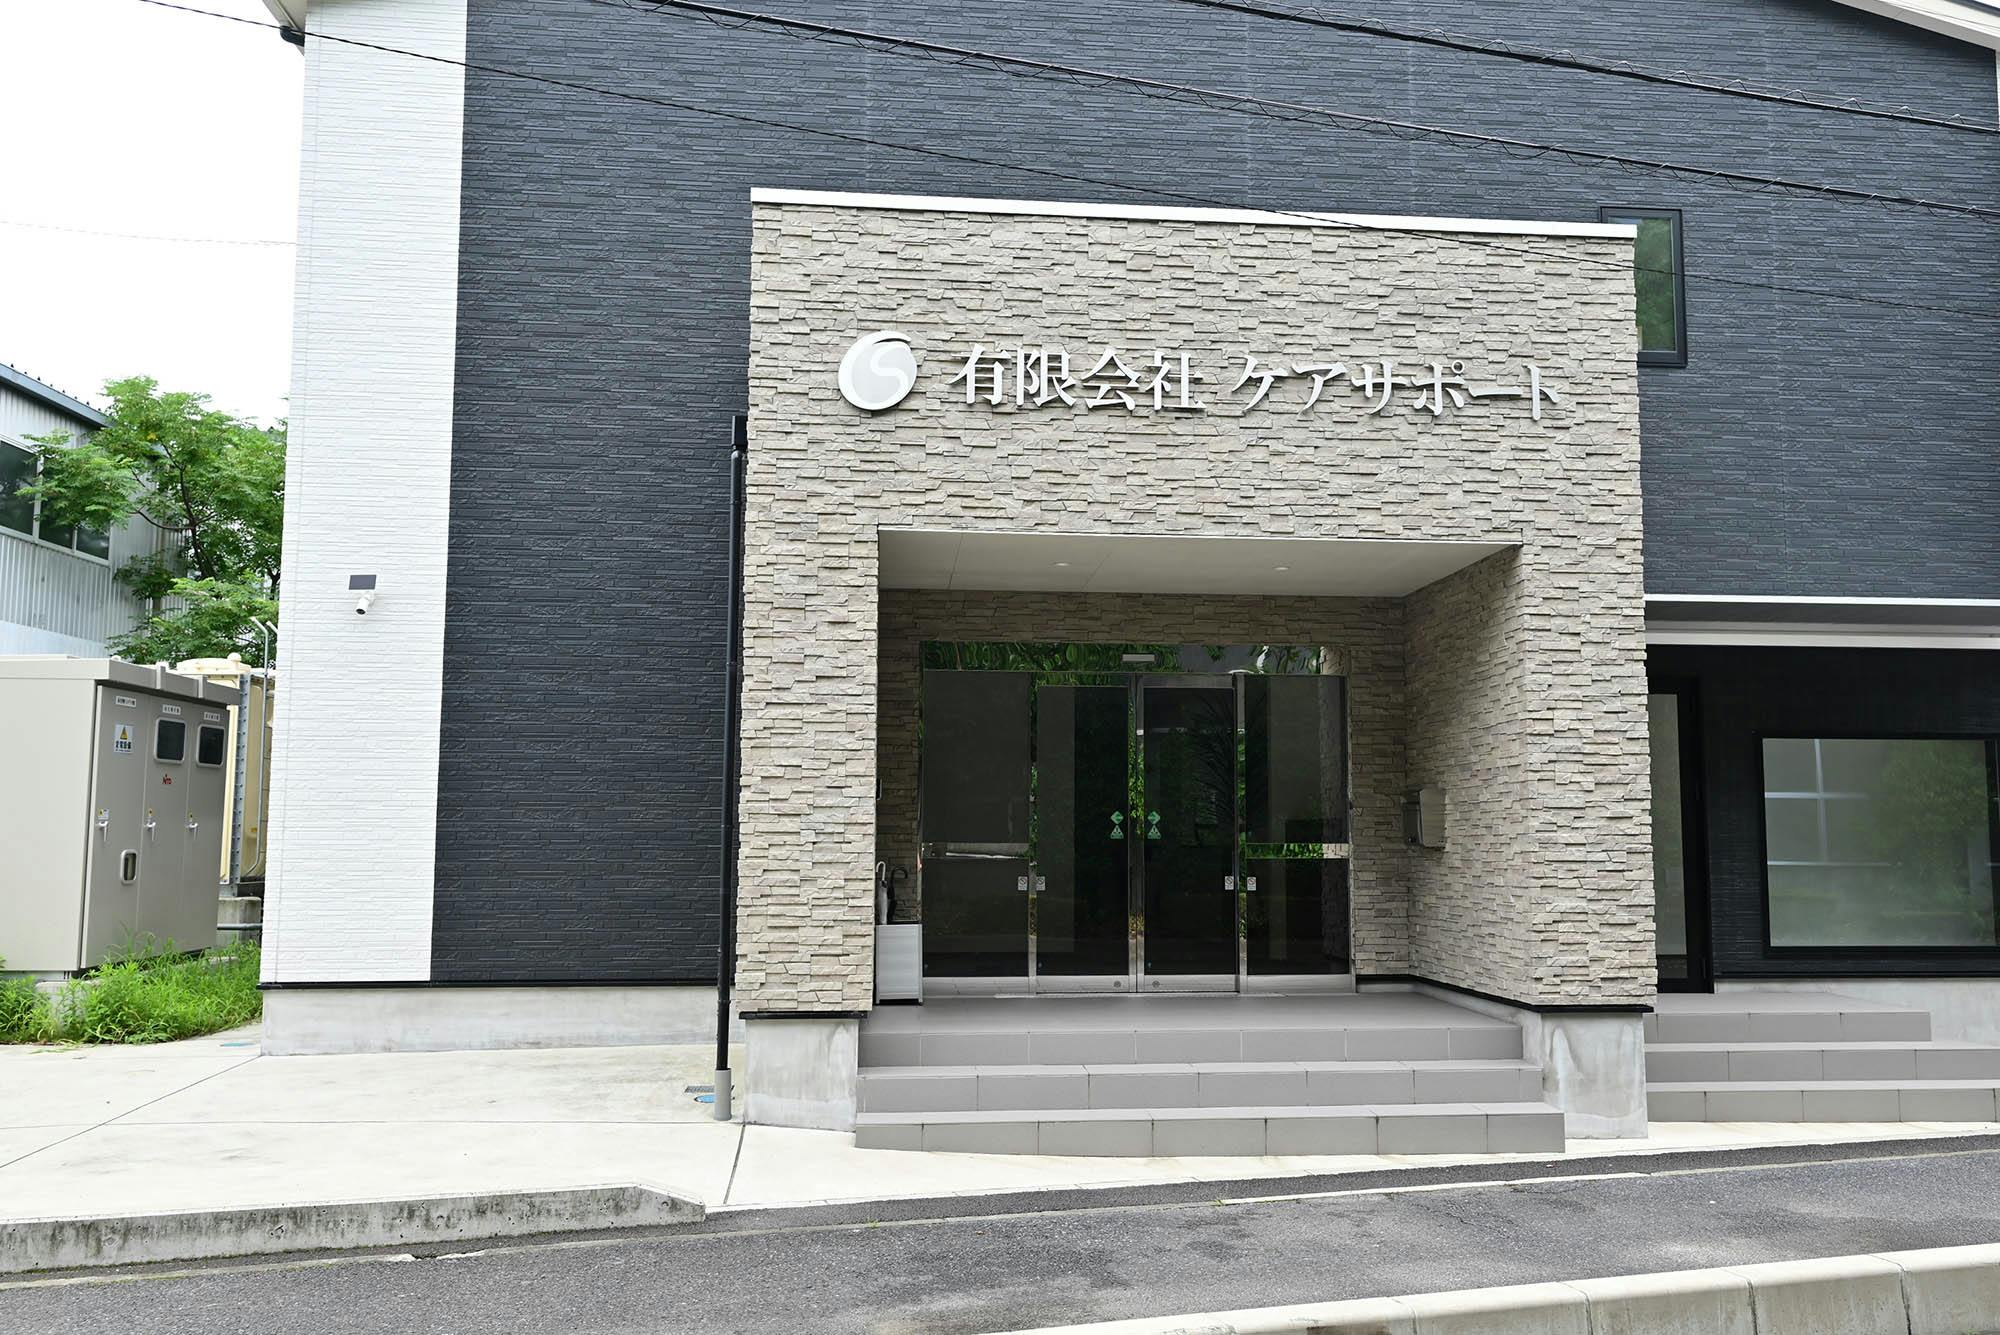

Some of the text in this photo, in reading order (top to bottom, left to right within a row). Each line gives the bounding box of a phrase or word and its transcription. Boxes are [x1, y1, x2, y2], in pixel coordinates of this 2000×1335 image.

[948, 343, 1561, 421] 有限会社 ケアサポート
